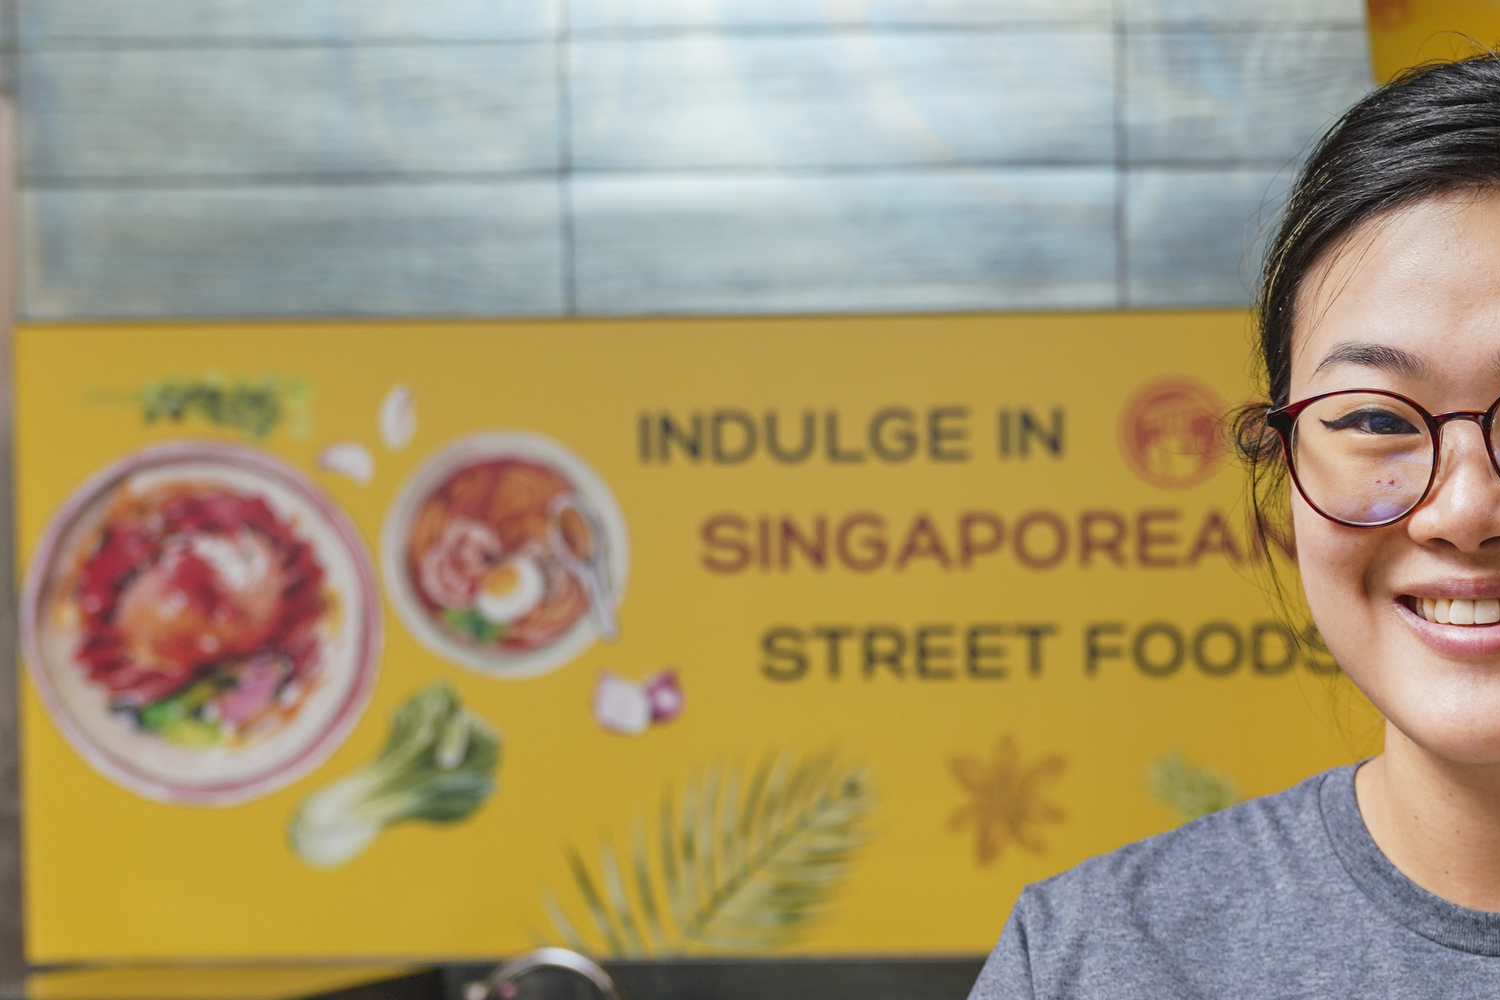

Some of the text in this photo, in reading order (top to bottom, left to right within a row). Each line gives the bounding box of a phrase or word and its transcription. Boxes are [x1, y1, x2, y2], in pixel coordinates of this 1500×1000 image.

[638, 407, 1066, 464] INDULGE IN
[760, 623, 1057, 682] STREET
